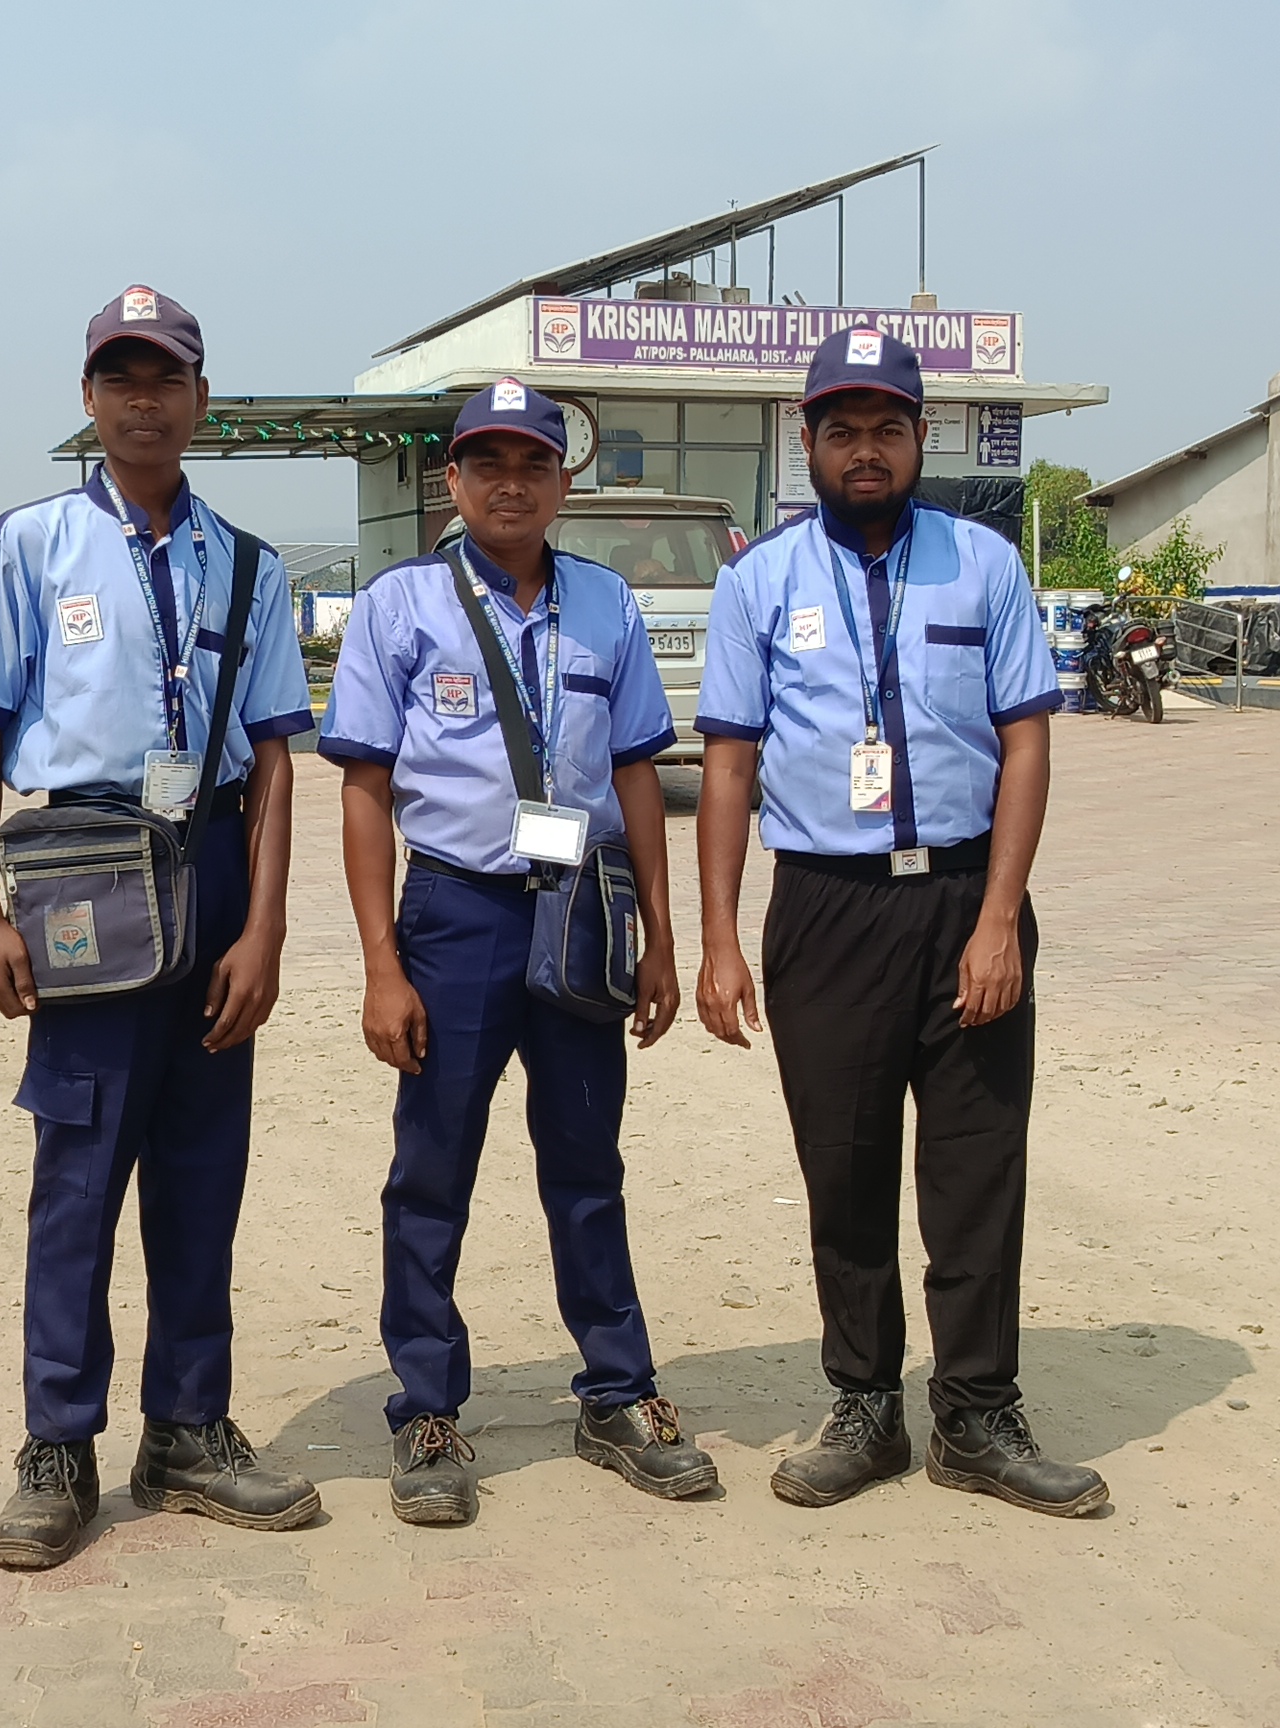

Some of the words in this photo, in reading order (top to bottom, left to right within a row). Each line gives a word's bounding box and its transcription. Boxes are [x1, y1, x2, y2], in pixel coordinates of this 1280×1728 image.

[551, 323, 569, 334] HP
[587, 304, 688, 342] KRISHNA
[694, 308, 778, 346] MARUTI
[876, 313, 966, 349] STATION
[982, 336, 999, 347] HP
[634, 345, 687, 360] AT/PO/PS-
[690, 347, 759, 365] PALLAHARA,
[570, 456, 576, 464] 5
[447, 688, 462, 698] HP
[61, 928, 79, 941] HP
